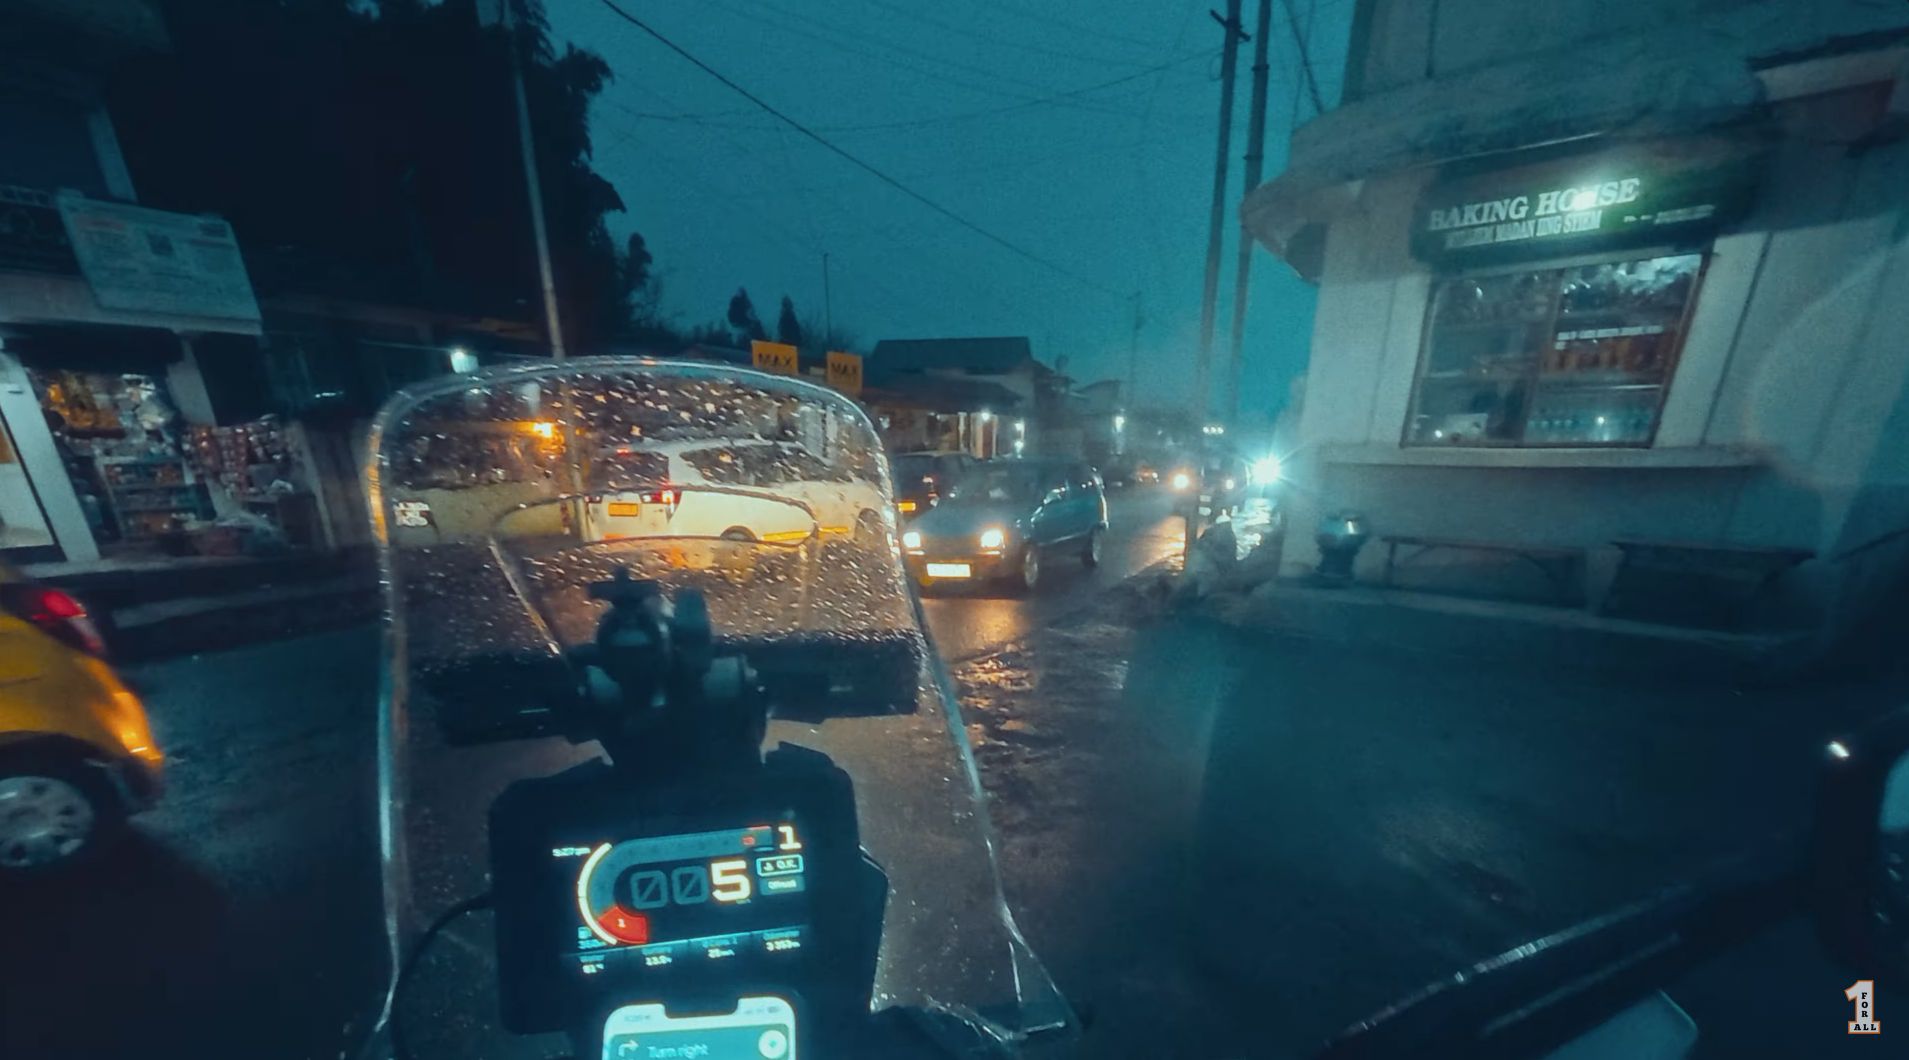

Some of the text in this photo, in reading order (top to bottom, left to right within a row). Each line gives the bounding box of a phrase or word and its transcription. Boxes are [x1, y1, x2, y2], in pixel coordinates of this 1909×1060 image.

[1427, 195, 1529, 230] BAKING
[1535, 177, 1641, 217] HOSE
[778, 825, 802, 850] 1
[647, 1043, 710, 1060] Turn right
